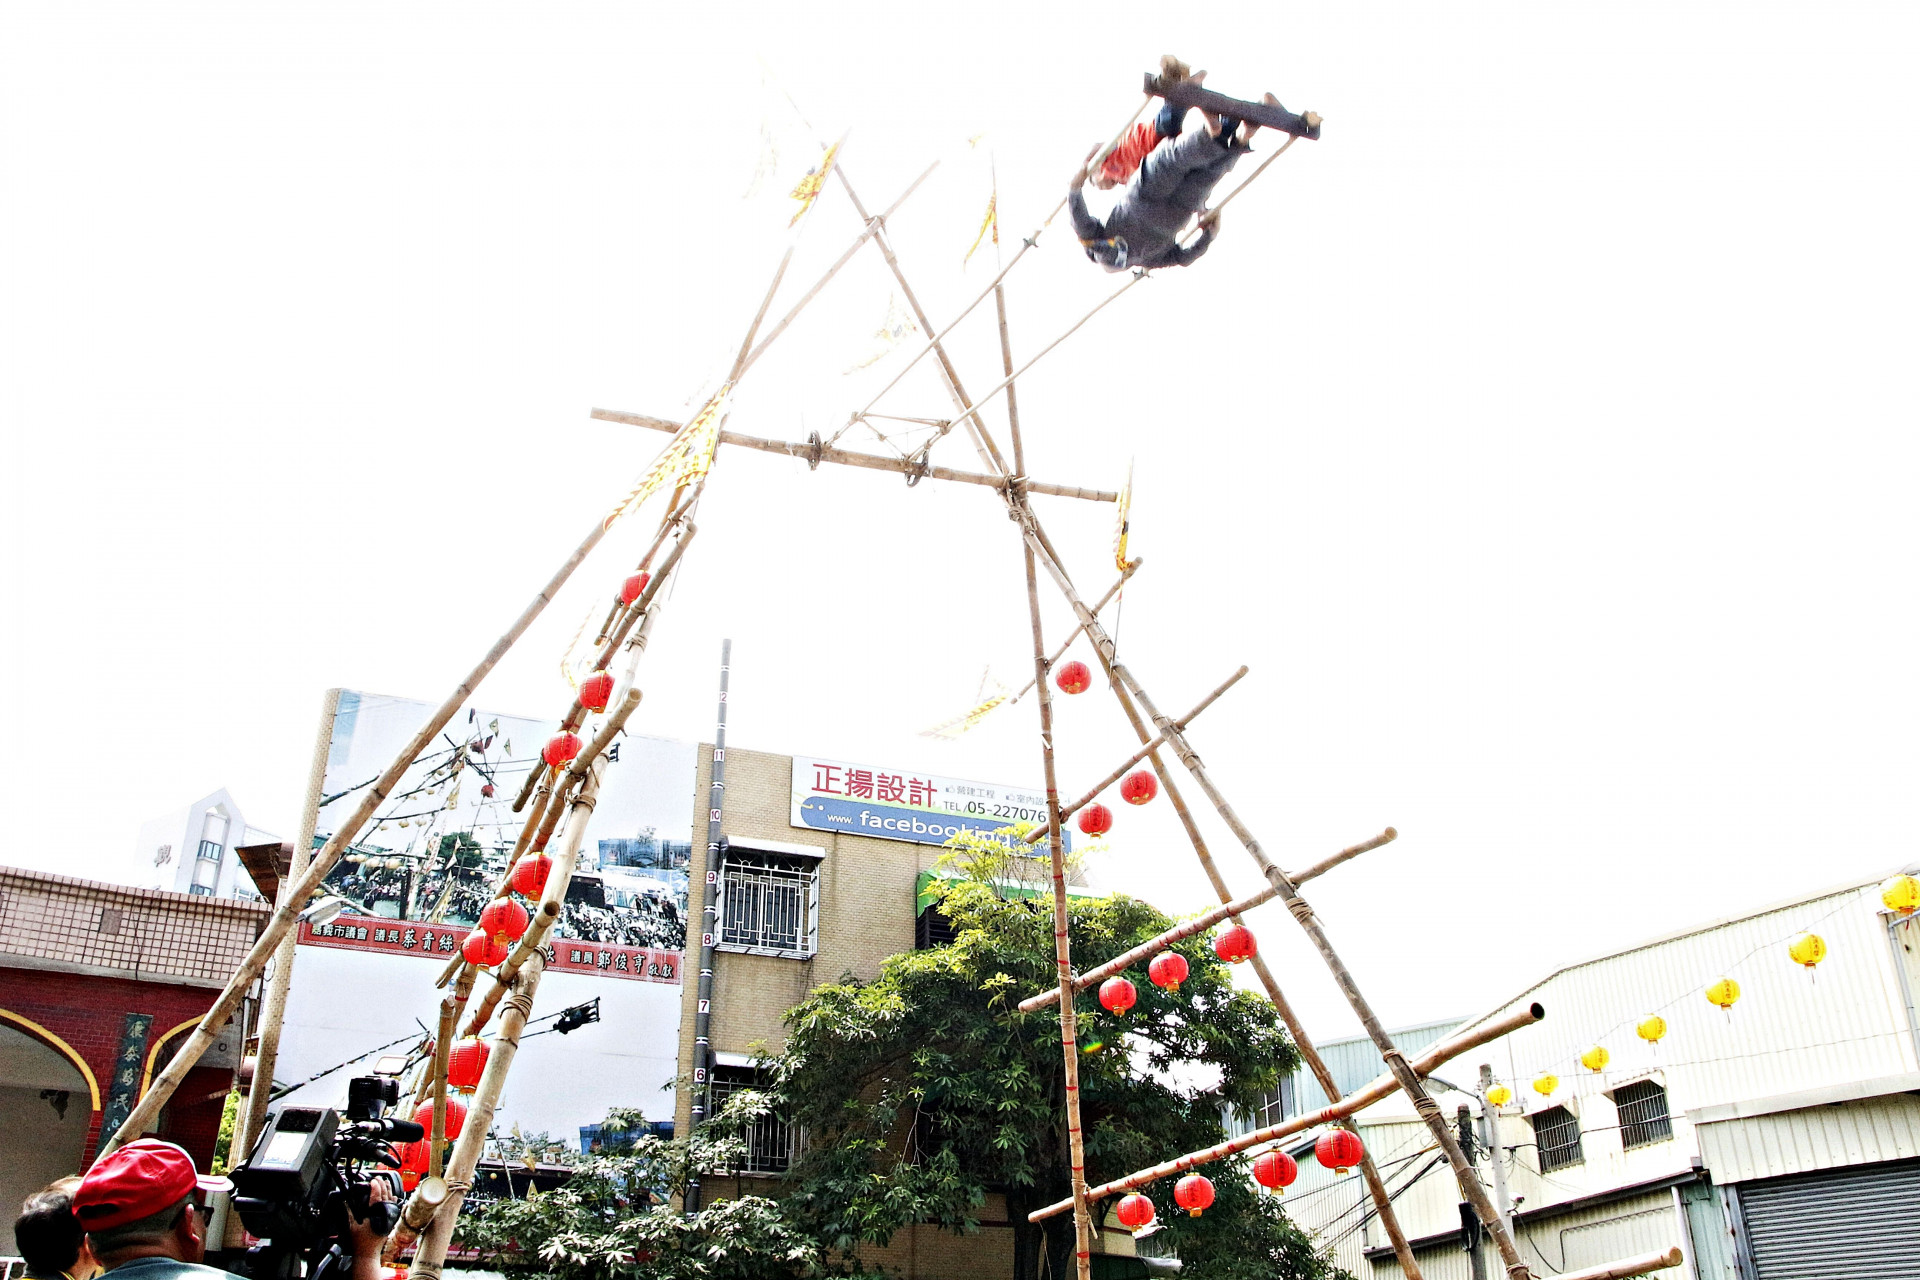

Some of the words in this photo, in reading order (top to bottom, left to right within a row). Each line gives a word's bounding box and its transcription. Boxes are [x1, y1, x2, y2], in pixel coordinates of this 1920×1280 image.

[715, 750, 723, 760] 11
[811, 763, 937, 808] 正揚設計
[1017, 794, 1048, 807] 室內設
[711, 810, 720, 820] 10
[827, 814, 854, 825] www.
[707, 873, 715, 883] 9
[704, 934, 711, 944] 8
[700, 1000, 708, 1011] 7
[697, 1069, 705, 1081] 6
